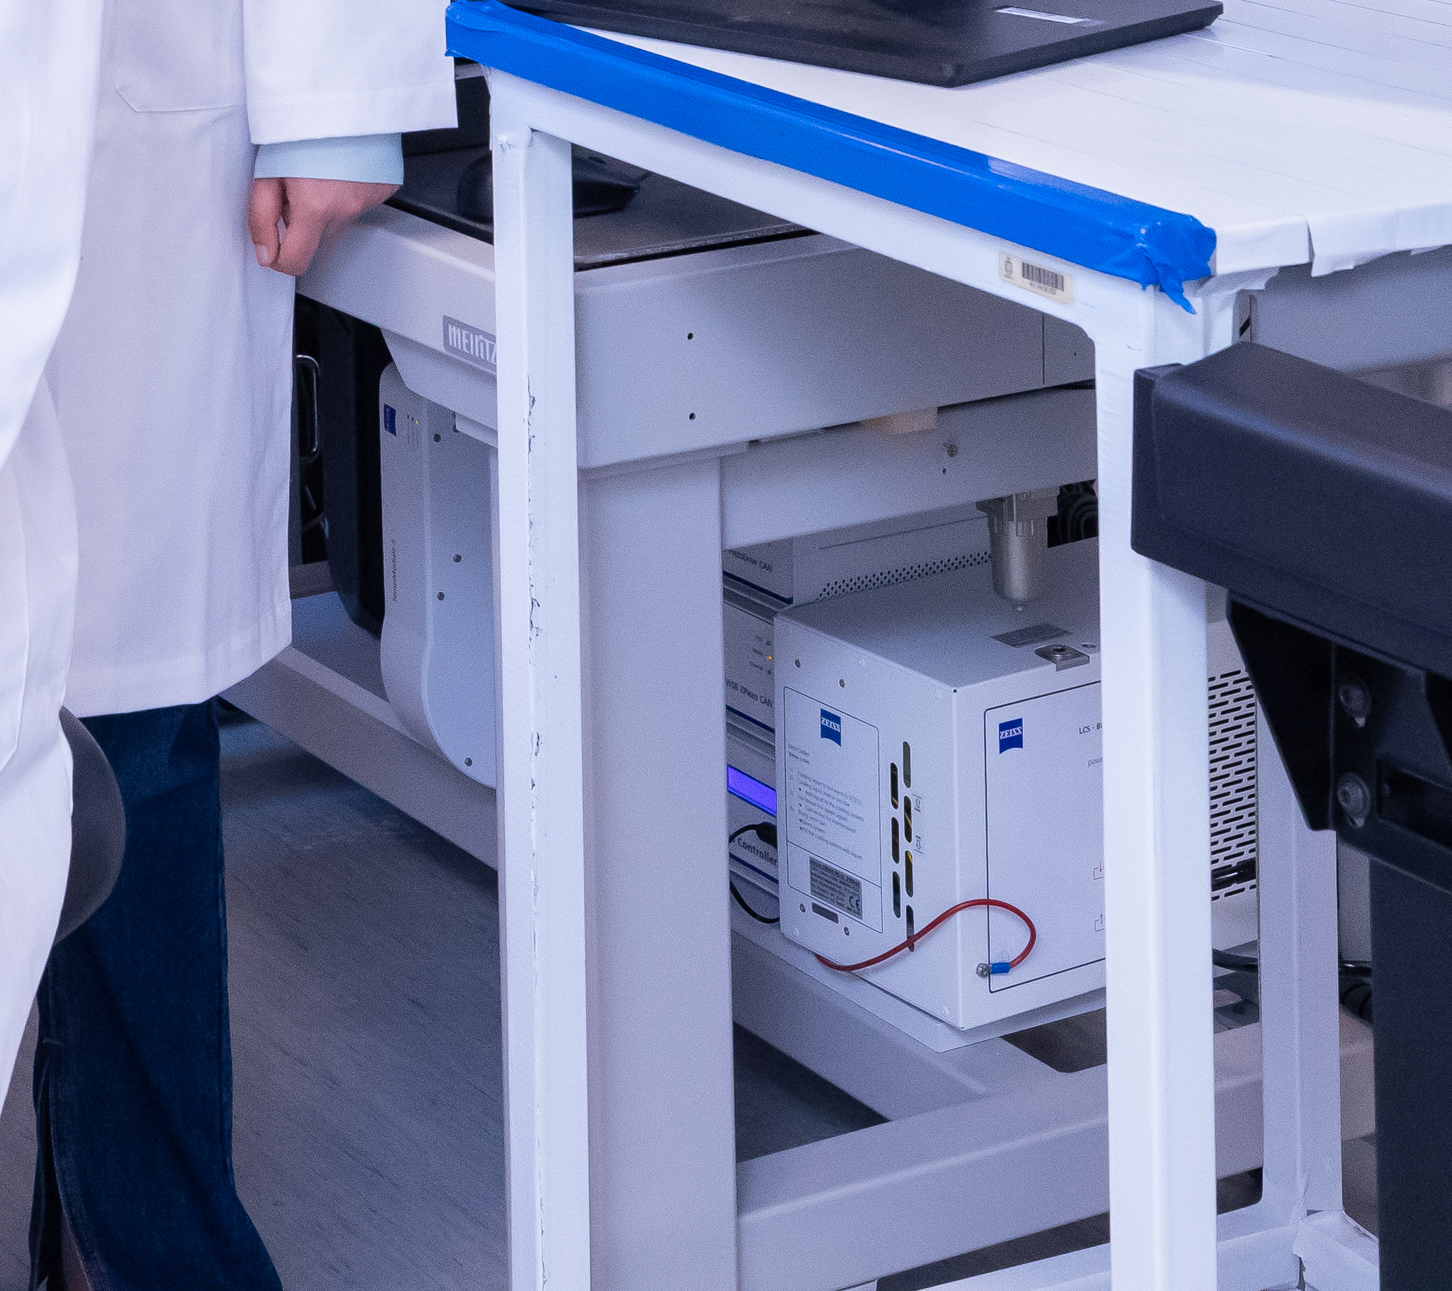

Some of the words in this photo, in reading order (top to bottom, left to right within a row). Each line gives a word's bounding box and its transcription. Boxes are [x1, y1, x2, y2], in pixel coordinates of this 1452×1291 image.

[821, 716, 841, 733] ZEISS
[999, 726, 1023, 740] ZEISS
[737, 837, 778, 867] Controller
